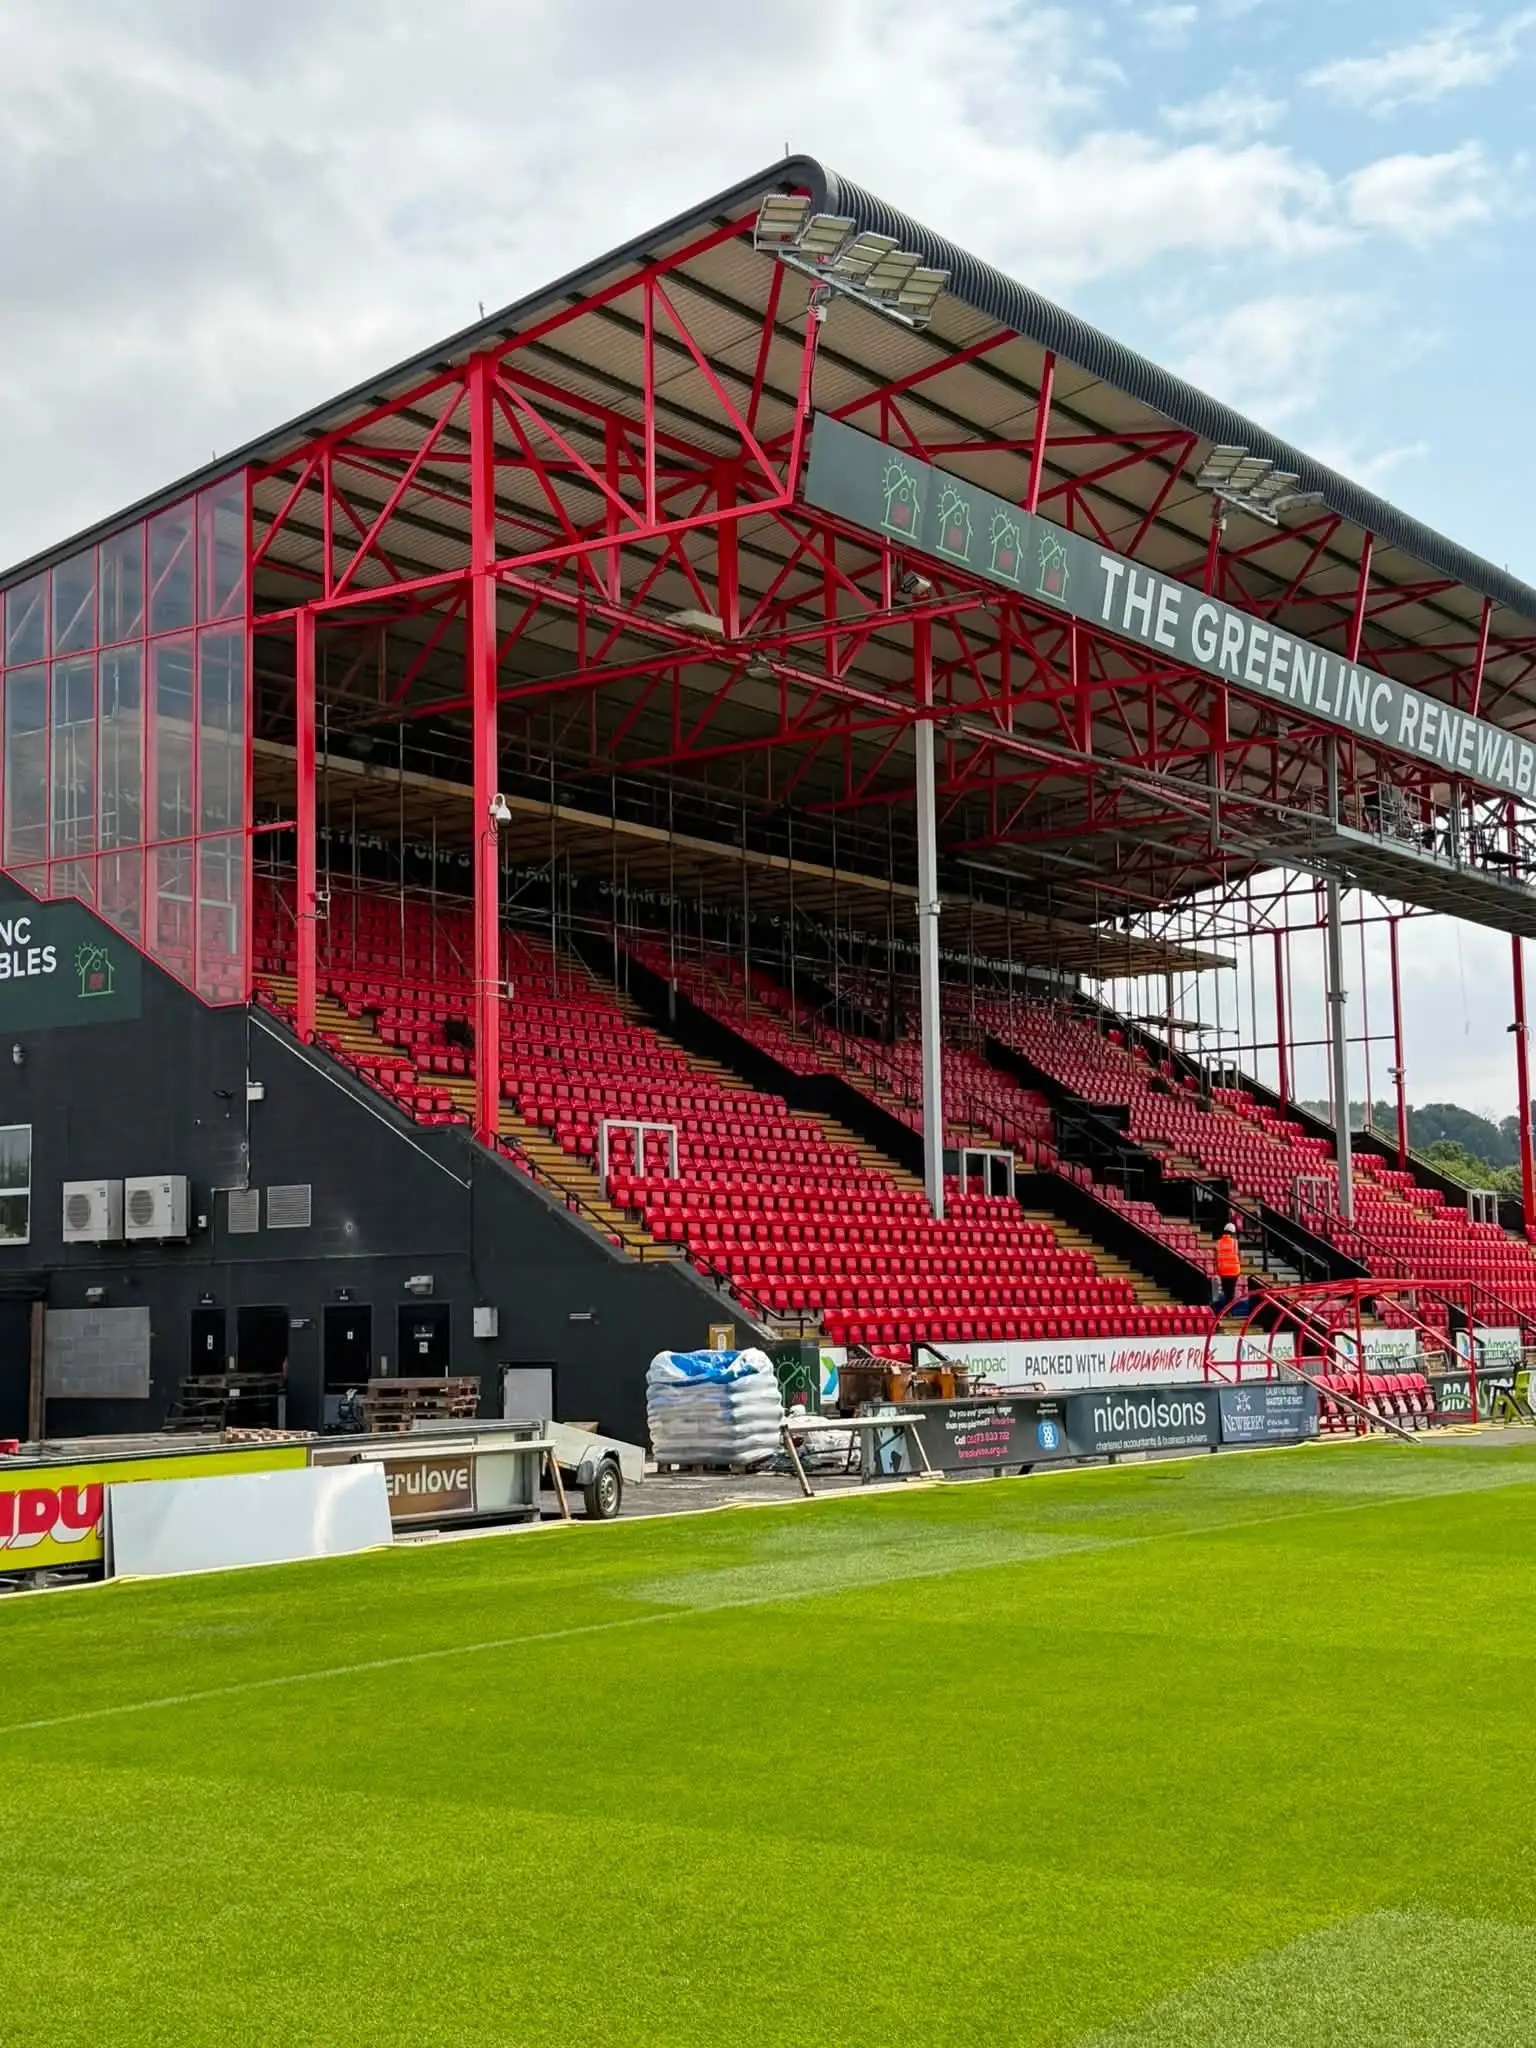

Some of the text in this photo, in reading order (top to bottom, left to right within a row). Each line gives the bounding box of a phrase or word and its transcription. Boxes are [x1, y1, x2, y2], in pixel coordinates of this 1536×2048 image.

[1100, 555, 1536, 797] THE GREENLINC RENEWAB
[0, 916, 31, 947] NC
[0, 945, 57, 979] BLES
[1025, 1347, 1218, 1376] PACKED WITH LINCOLNSHIRE PRIE
[1094, 1396, 1206, 1433] nicholsons
[954, 1435, 967, 1445] Call
[1096, 1439, 1123, 1450] chartered
[1123, 1437, 1157, 1449] accountants
[1163, 1435, 1185, 1446] business
